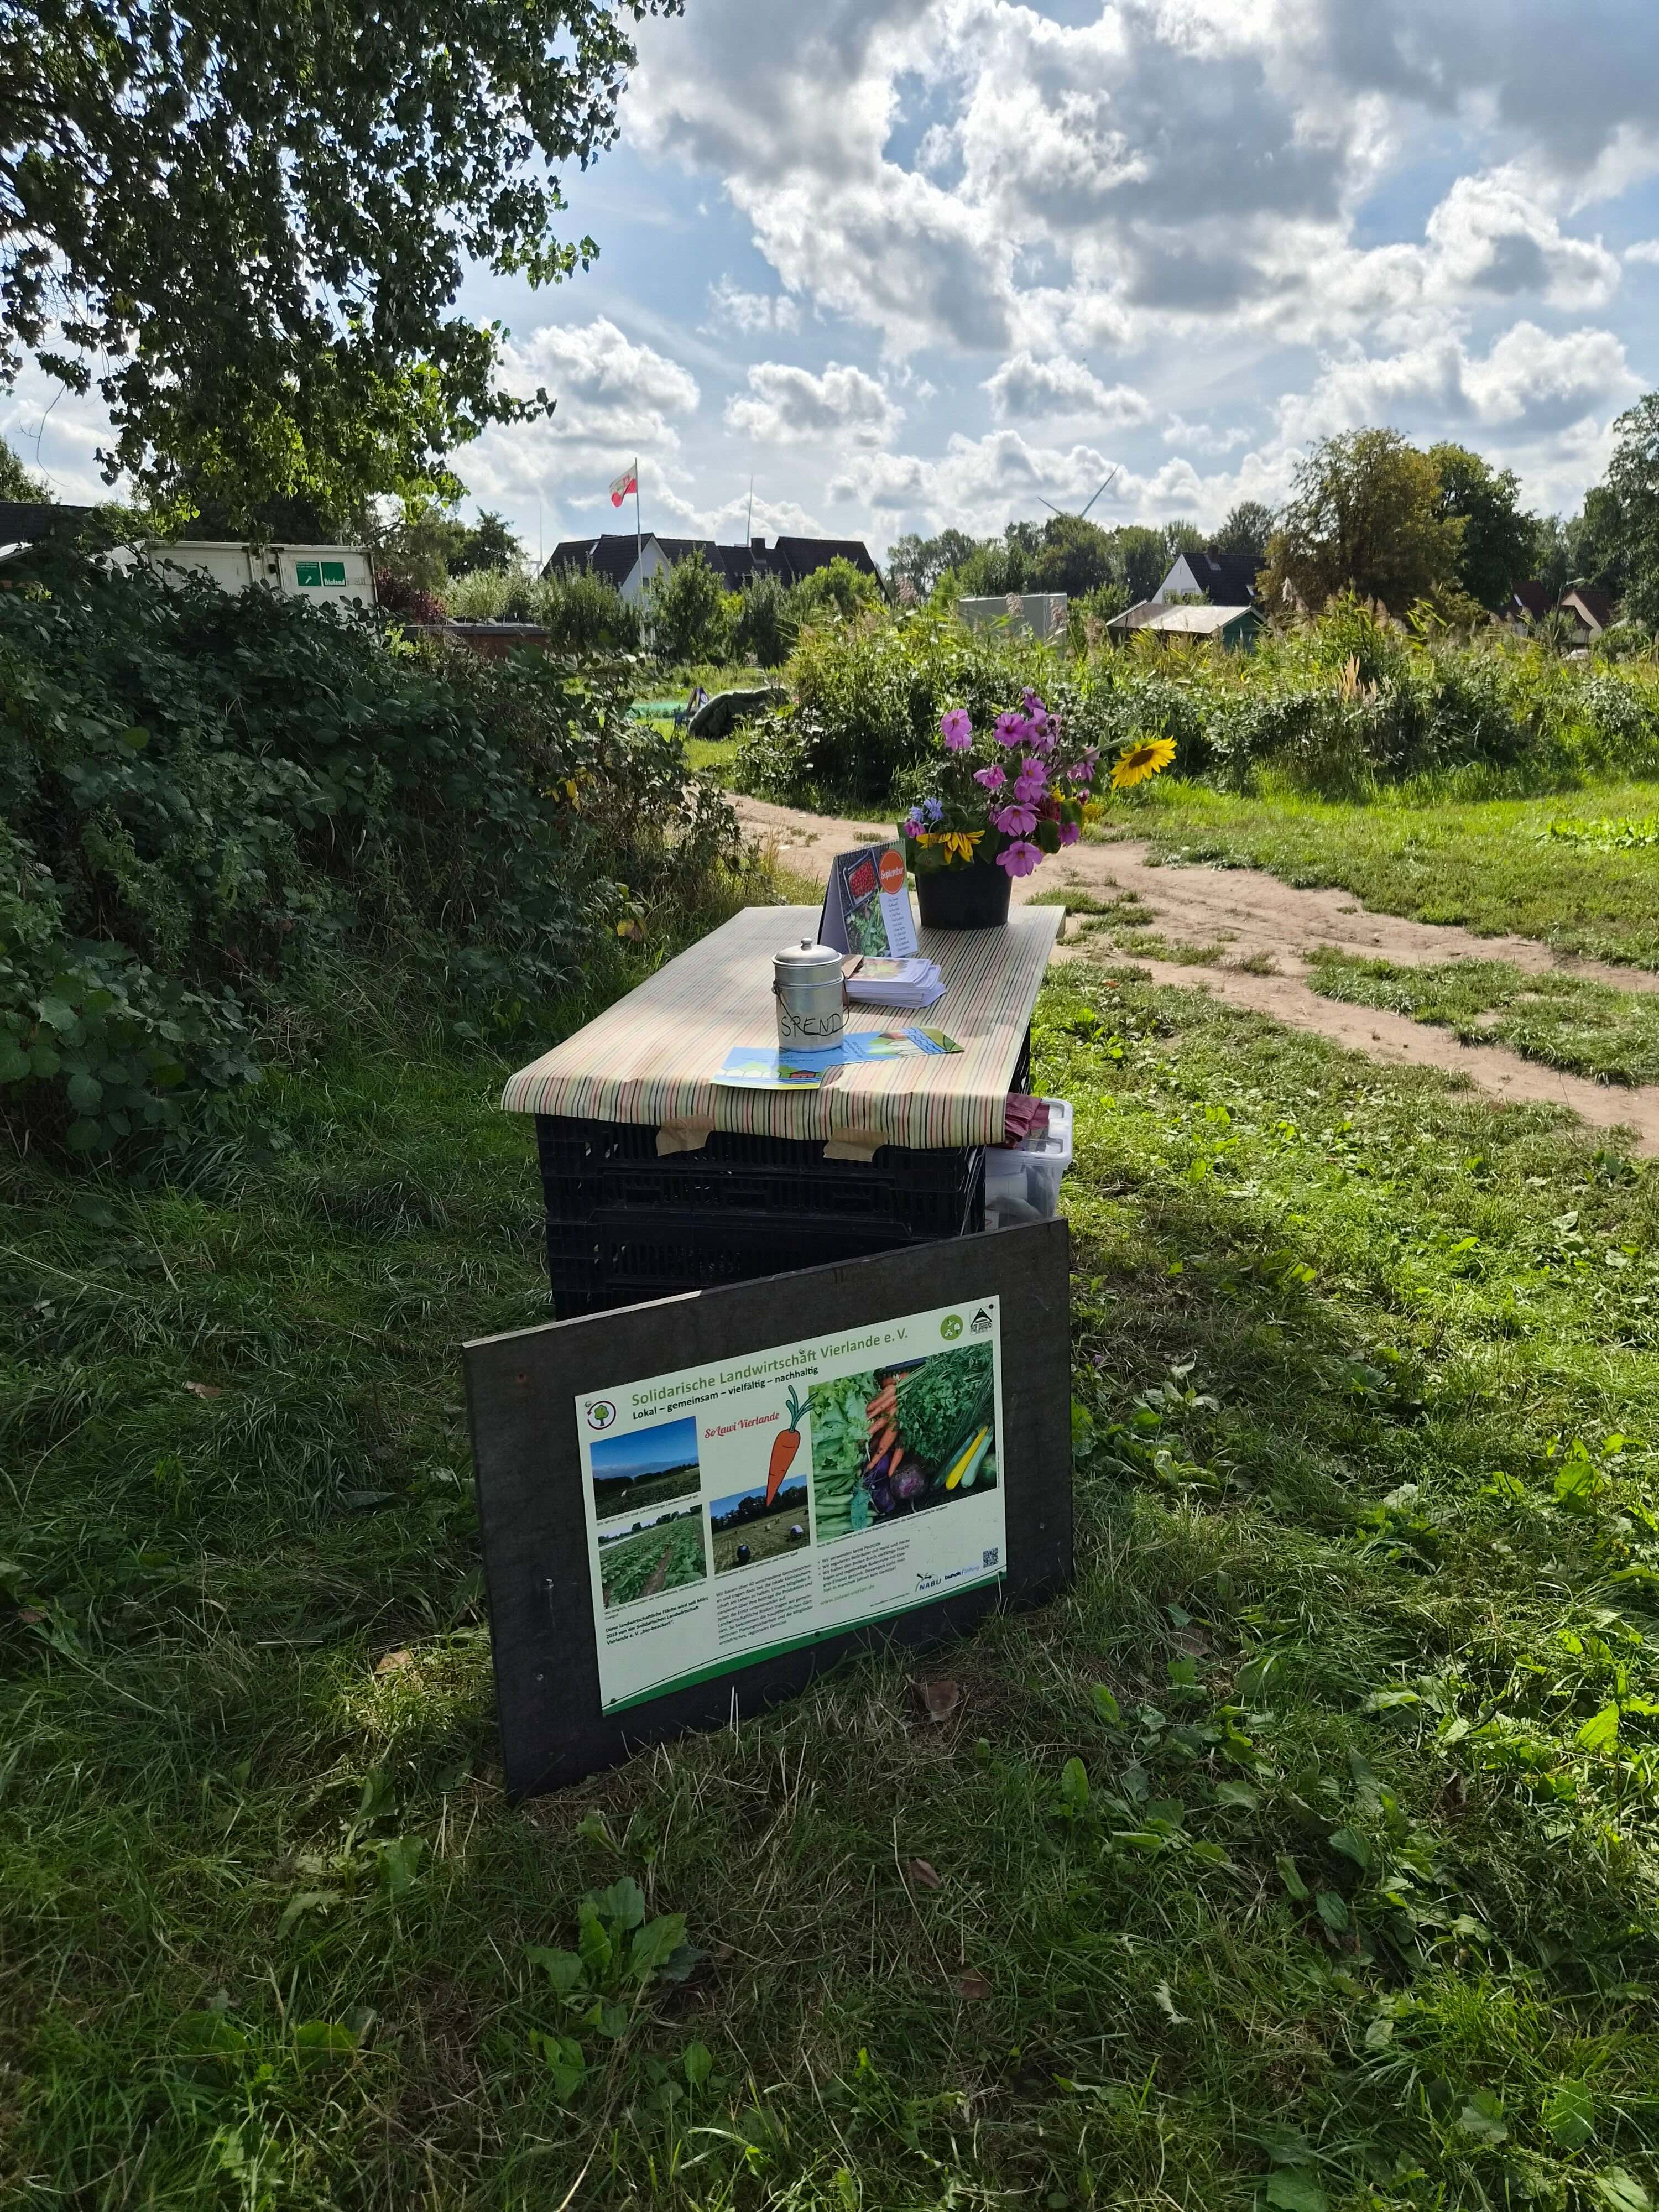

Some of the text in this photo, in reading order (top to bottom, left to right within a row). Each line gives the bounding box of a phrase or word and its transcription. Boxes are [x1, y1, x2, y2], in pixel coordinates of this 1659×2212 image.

[880, 867, 904, 880] September
[632, 1378, 714, 1405] Solidarische
[720, 1350, 816, 1383] Landwirtschaft
[820, 1336, 879, 1357] Vierlande
[896, 1328, 907, 1339] V.
[633, 1366, 818, 1419] Lokal gemeinsam vielfältig nachhaltig
[705, 1412, 779, 1438] SoLawi Vierlande
[865, 1564, 885, 1573] Deswegen
[755, 1574, 781, 1584] verschiedene
[786, 1578, 806, 1586] Mitglieder
[919, 1579, 941, 1590] NABU
[717, 1606, 737, 1614] nanzieren
[782, 1584, 804, 1593] Produktion
[749, 1599, 778, 1610] untereinander
[792, 1605, 812, 1614] Mitglieder
[619, 1612, 661, 1627] landwirtschaftliche
[637, 1617, 665, 1629] Solidarischen
[667, 1605, 698, 1619] Landwirtschaft
[718, 1611, 758, 1627] Landwirtschaftliche
[735, 1618, 758, 1627] bekommen
[607, 1635, 628, 1645] Vierlande
